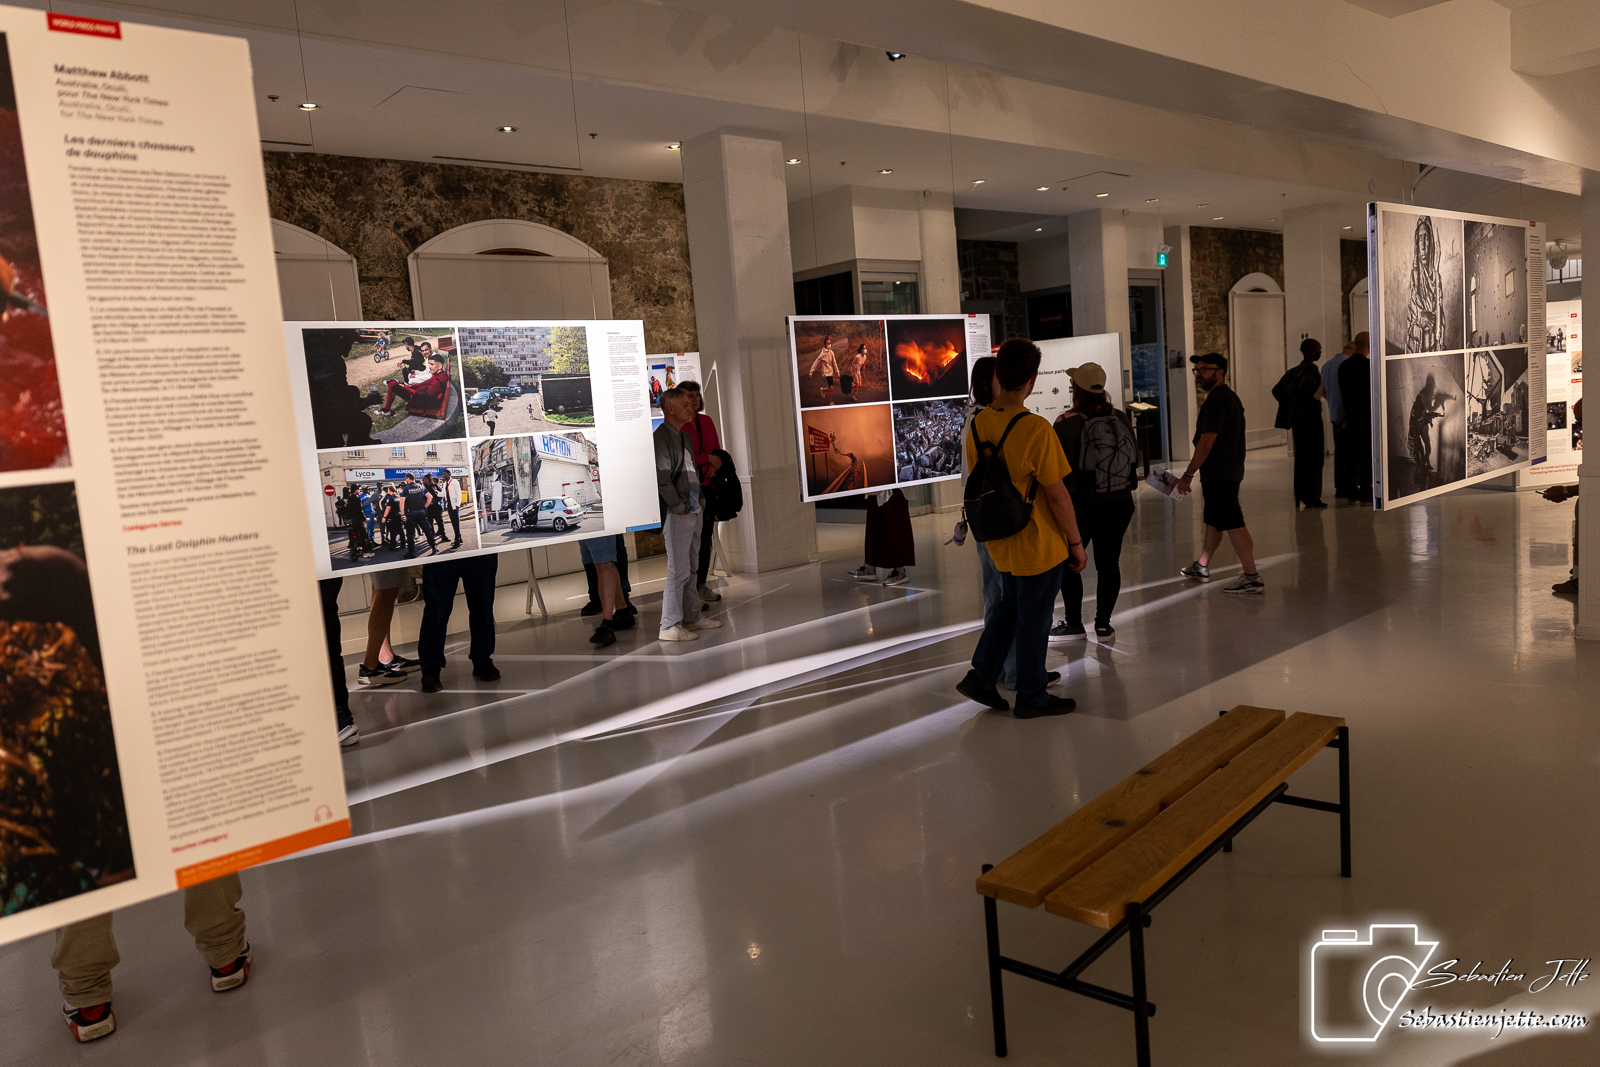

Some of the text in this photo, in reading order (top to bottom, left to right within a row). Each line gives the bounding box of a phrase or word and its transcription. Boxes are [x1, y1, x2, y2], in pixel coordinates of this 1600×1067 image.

[64, 133, 85, 144] Les
[87, 136, 136, 149] derniers
[542, 435, 572, 457] ACTION
[355, 470, 371, 478] Lyca
[126, 531, 260, 555] The Last Dolphin Hunters
